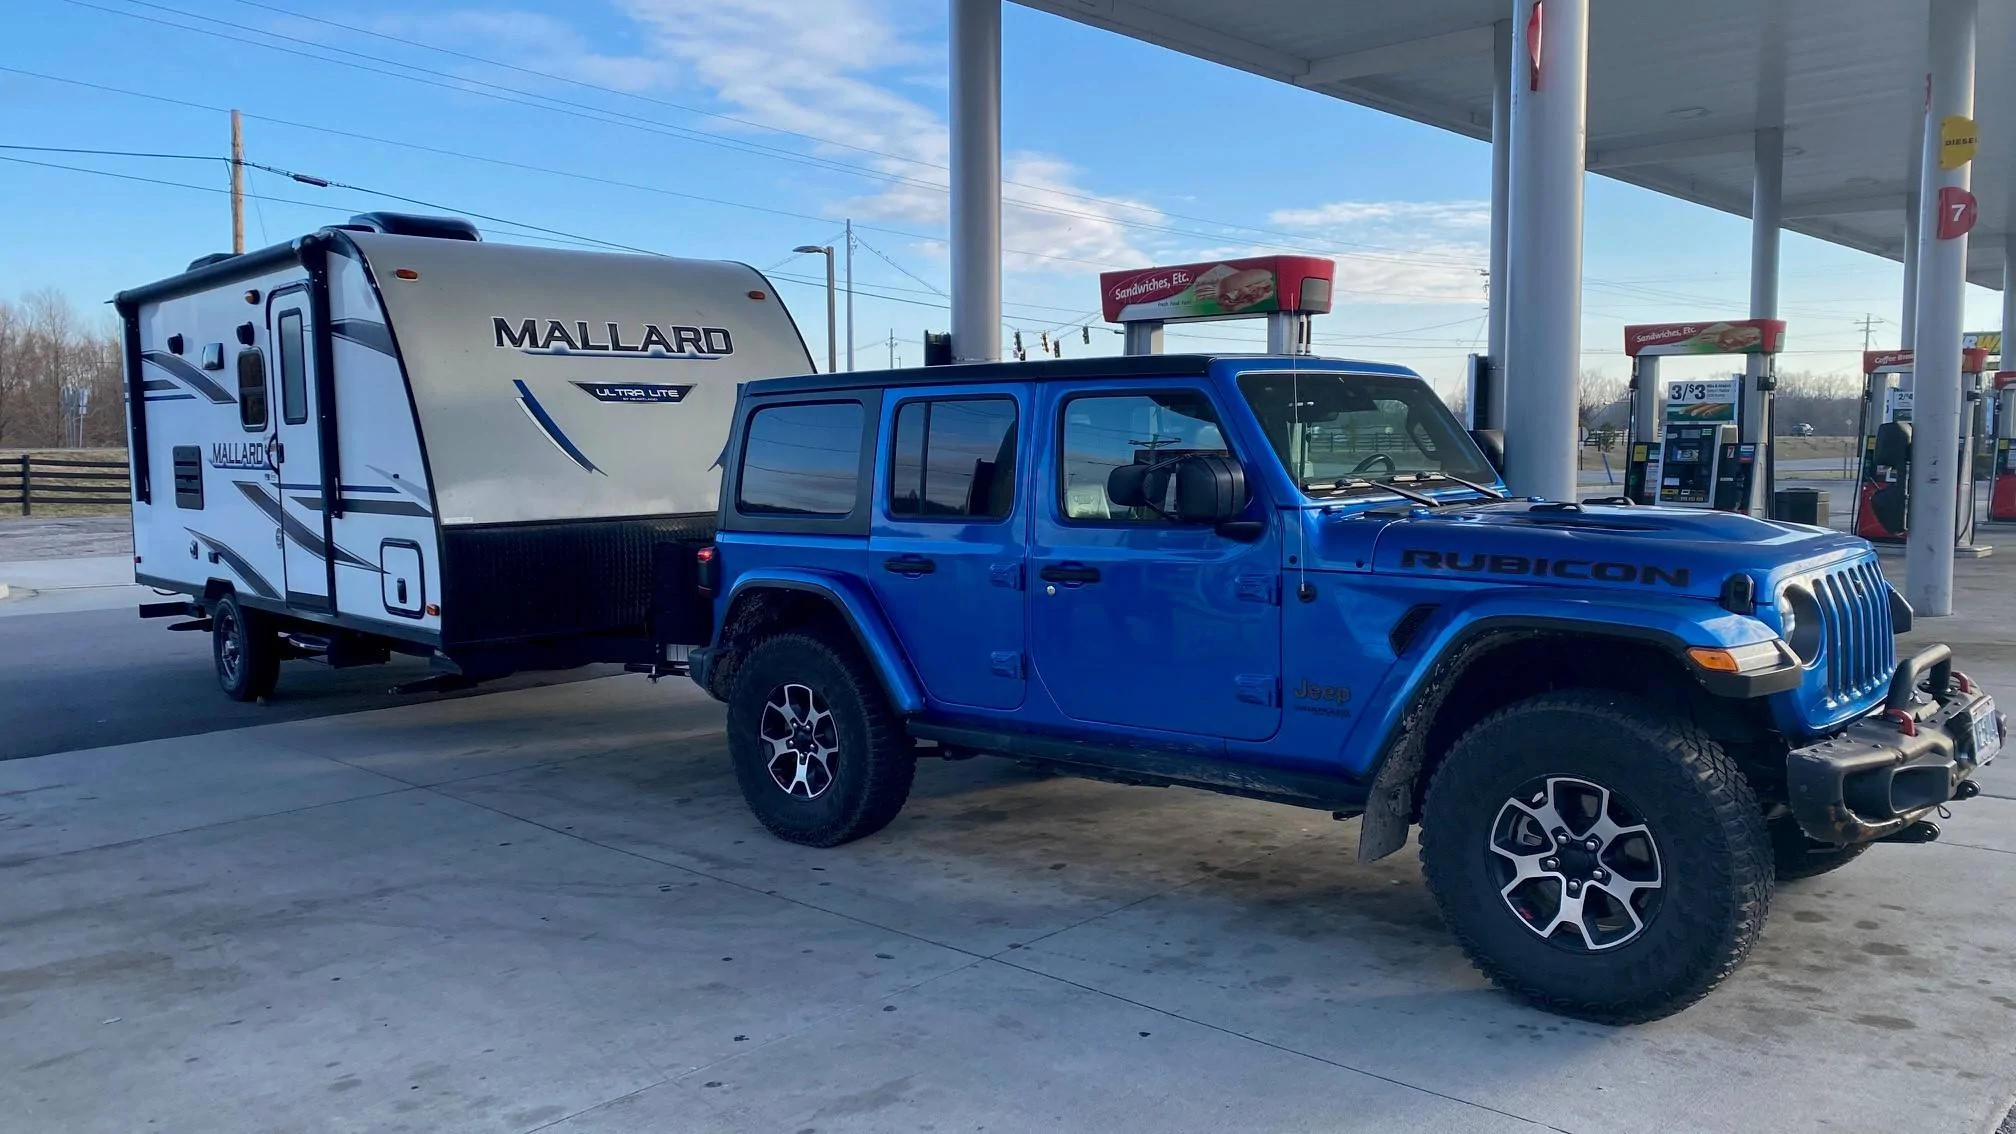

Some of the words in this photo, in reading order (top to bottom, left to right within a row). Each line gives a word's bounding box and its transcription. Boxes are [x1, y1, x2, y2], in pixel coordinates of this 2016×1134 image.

[1945, 136, 1979, 146] DIESEL
[1951, 204, 1966, 222] 7
[1115, 277, 1171, 300] Sandwiches,
[1172, 272, 1190, 285] Etc.
[491, 316, 735, 355] MALLARD
[1636, 329, 1682, 343] Sandwiches,
[595, 388, 645, 397] ULTRA
[648, 389, 680, 398] LITE
[1671, 383, 1706, 401] 3/$3
[212, 442, 264, 465] MALLARD
[1400, 549, 1690, 588] RUBICON
[1293, 679, 1352, 704] Jeep
